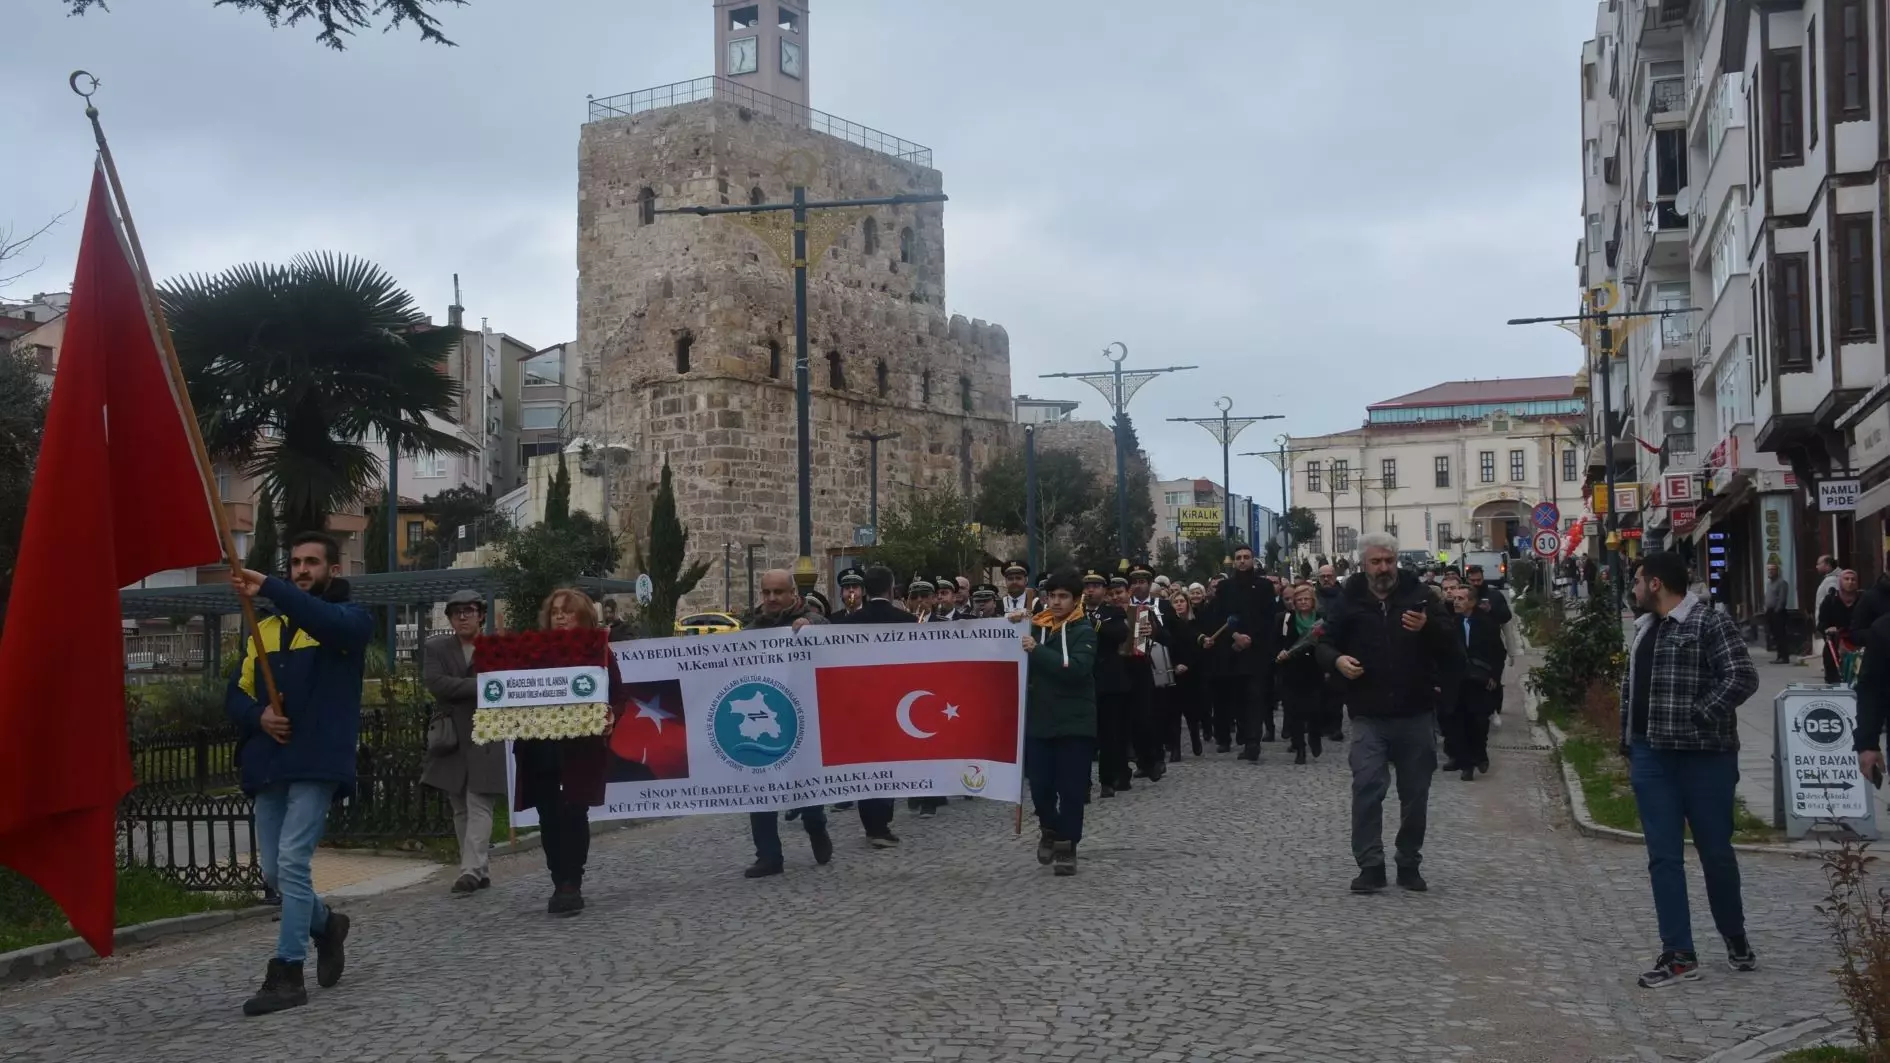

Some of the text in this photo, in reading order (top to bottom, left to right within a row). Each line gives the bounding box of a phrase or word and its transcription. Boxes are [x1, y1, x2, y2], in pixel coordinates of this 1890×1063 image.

[1672, 480, 1687, 496] E
[1538, 537, 1556, 550] 30
[622, 643, 710, 661] KAYBEDİLMİŞ
[714, 640, 757, 657] VATAN
[760, 633, 870, 650] TOPRAKLARININ
[873, 629, 904, 643] AZİZ
[908, 628, 1019, 642] HATIRALARIDIR.
[677, 651, 811, 673] M.Kemal ATATÜRK 1931
[1805, 719, 1842, 733] DES
[1794, 755, 1857, 766] BAY BAYAN
[1831, 769, 1858, 780] TAKI
[639, 786, 678, 800] SİNOP
[681, 783, 751, 798] MÜBADELE
[768, 775, 821, 791] BALKAN
[824, 770, 894, 785] HALKLARI
[609, 778, 934, 814] KÜLTÜR ARAŞTIRMALARI VE DAYANIŞMA DERNEĞİ
